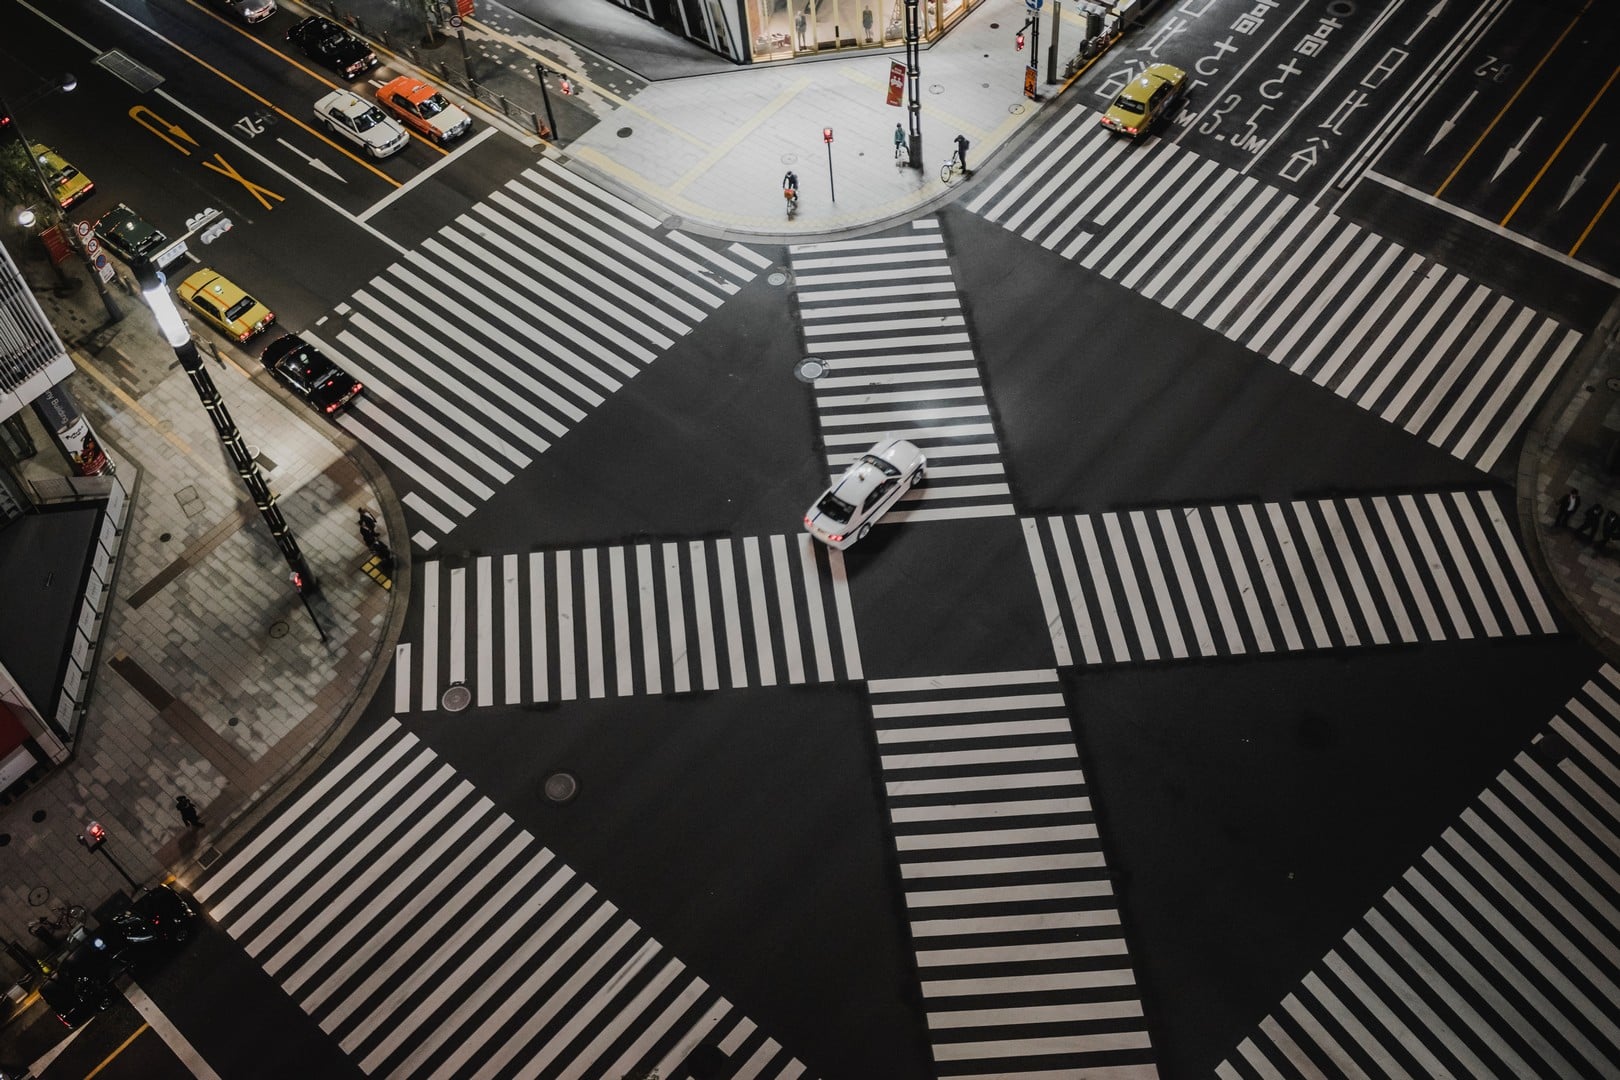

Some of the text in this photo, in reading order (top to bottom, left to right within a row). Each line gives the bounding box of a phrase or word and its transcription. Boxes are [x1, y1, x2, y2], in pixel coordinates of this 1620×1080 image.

[1258, 17, 1343, 100] 高さ
[1278, 47, 1410, 182] 日比谷
